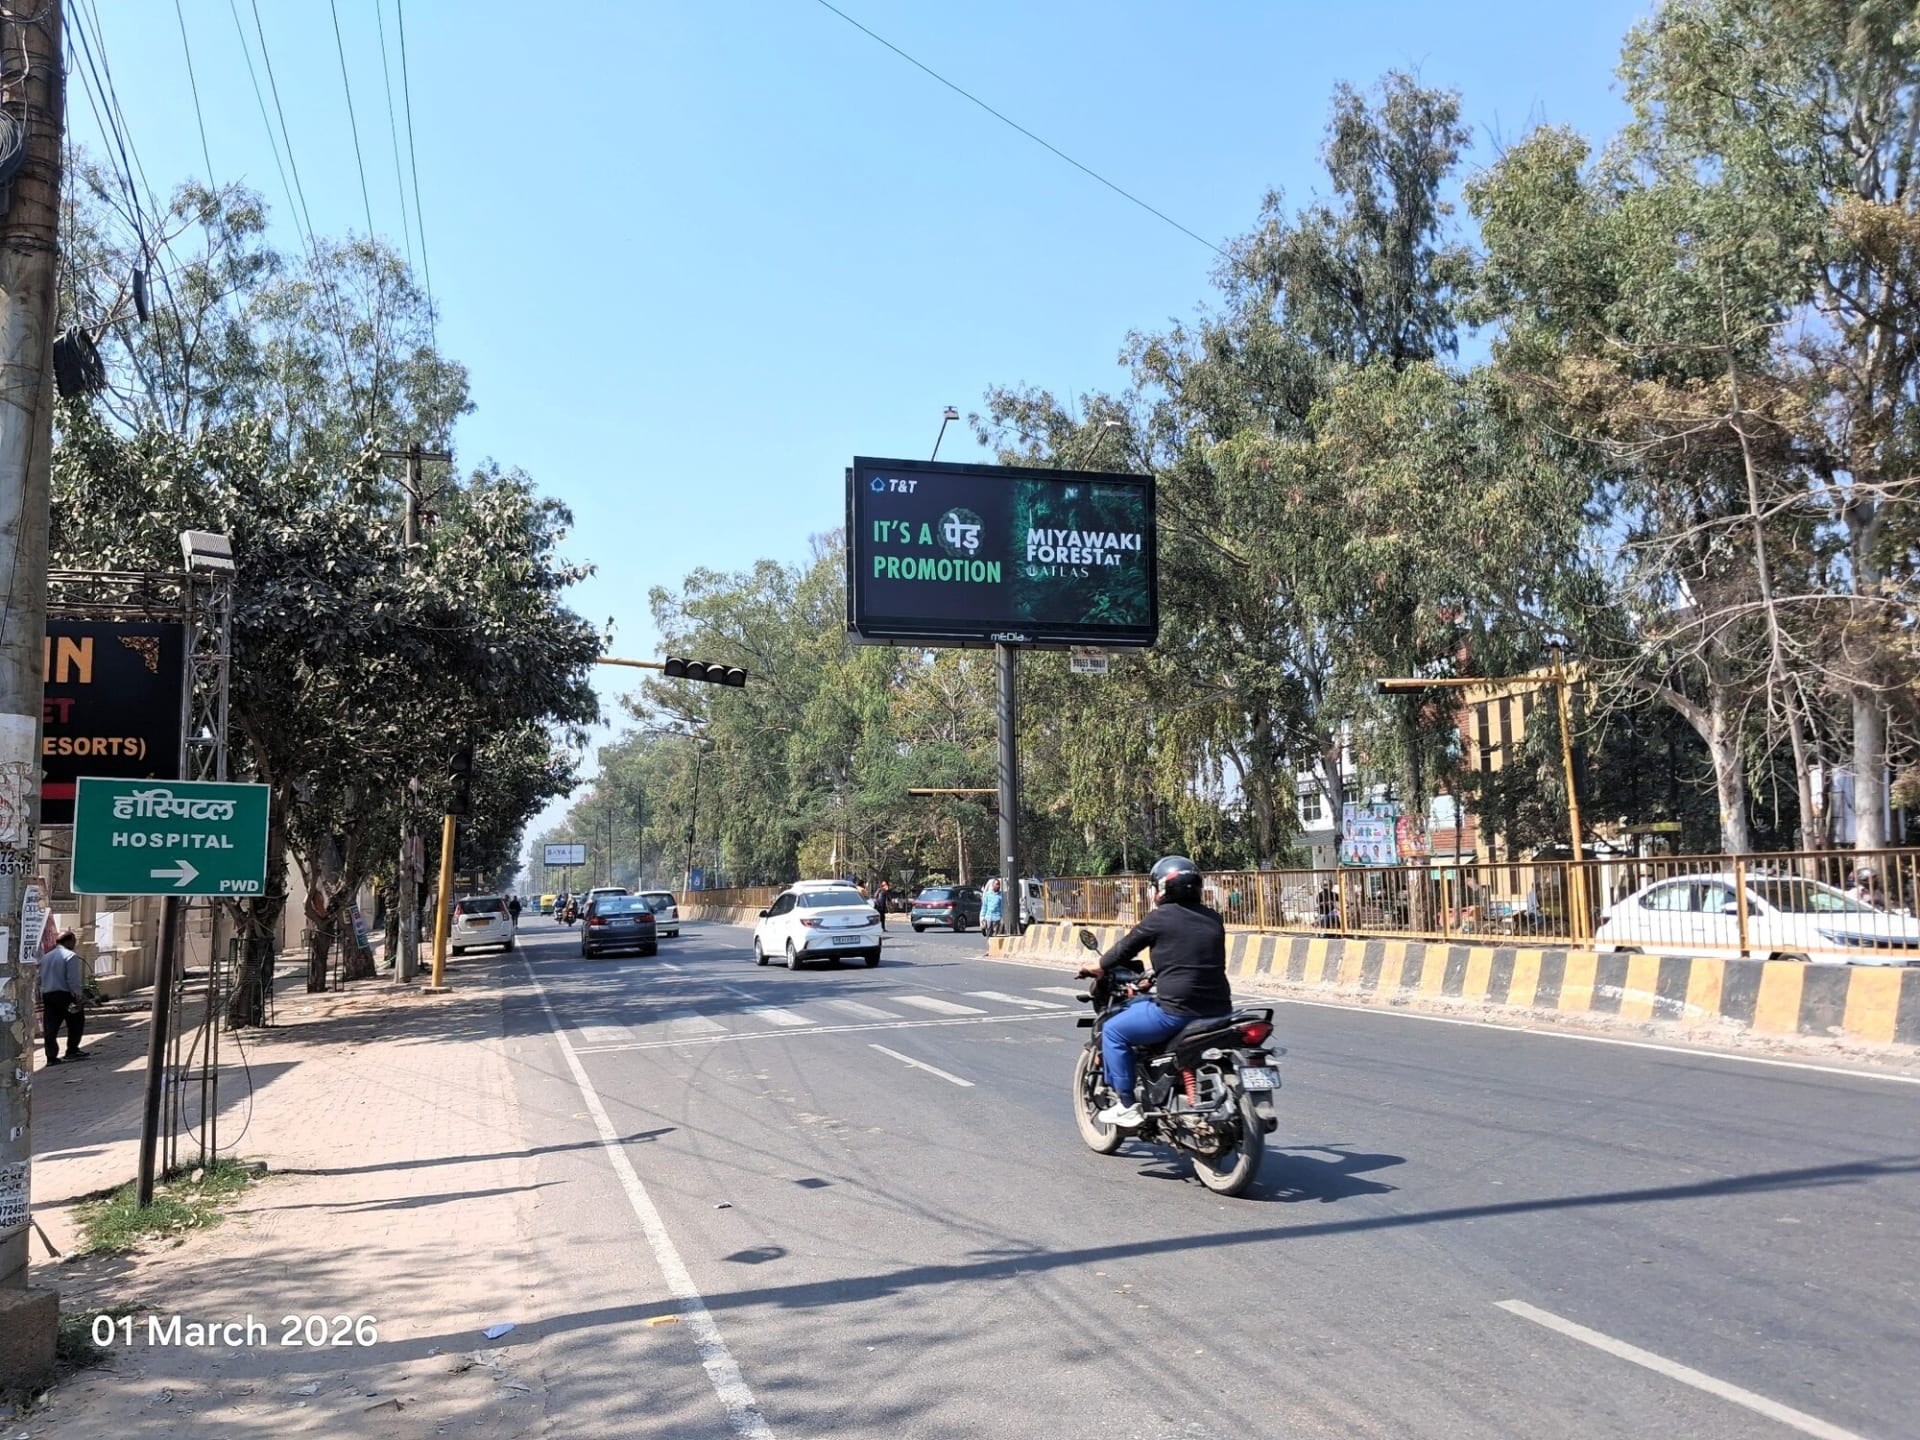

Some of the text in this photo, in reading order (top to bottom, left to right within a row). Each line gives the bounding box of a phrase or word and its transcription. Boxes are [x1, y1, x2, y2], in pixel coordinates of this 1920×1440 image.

[889, 479, 918, 493] T&T
[918, 523, 933, 545] A
[1026, 527, 1141, 551] MIYAWAKI
[1026, 544, 1122, 566] FOREST AT
[873, 555, 1001, 583] PROMOTION
[1041, 565, 1089, 578] ATLAS
[113, 788, 237, 821] हॉस्पिटल
[112, 832, 234, 849] HOSPITAL
[219, 879, 259, 892] PWD
